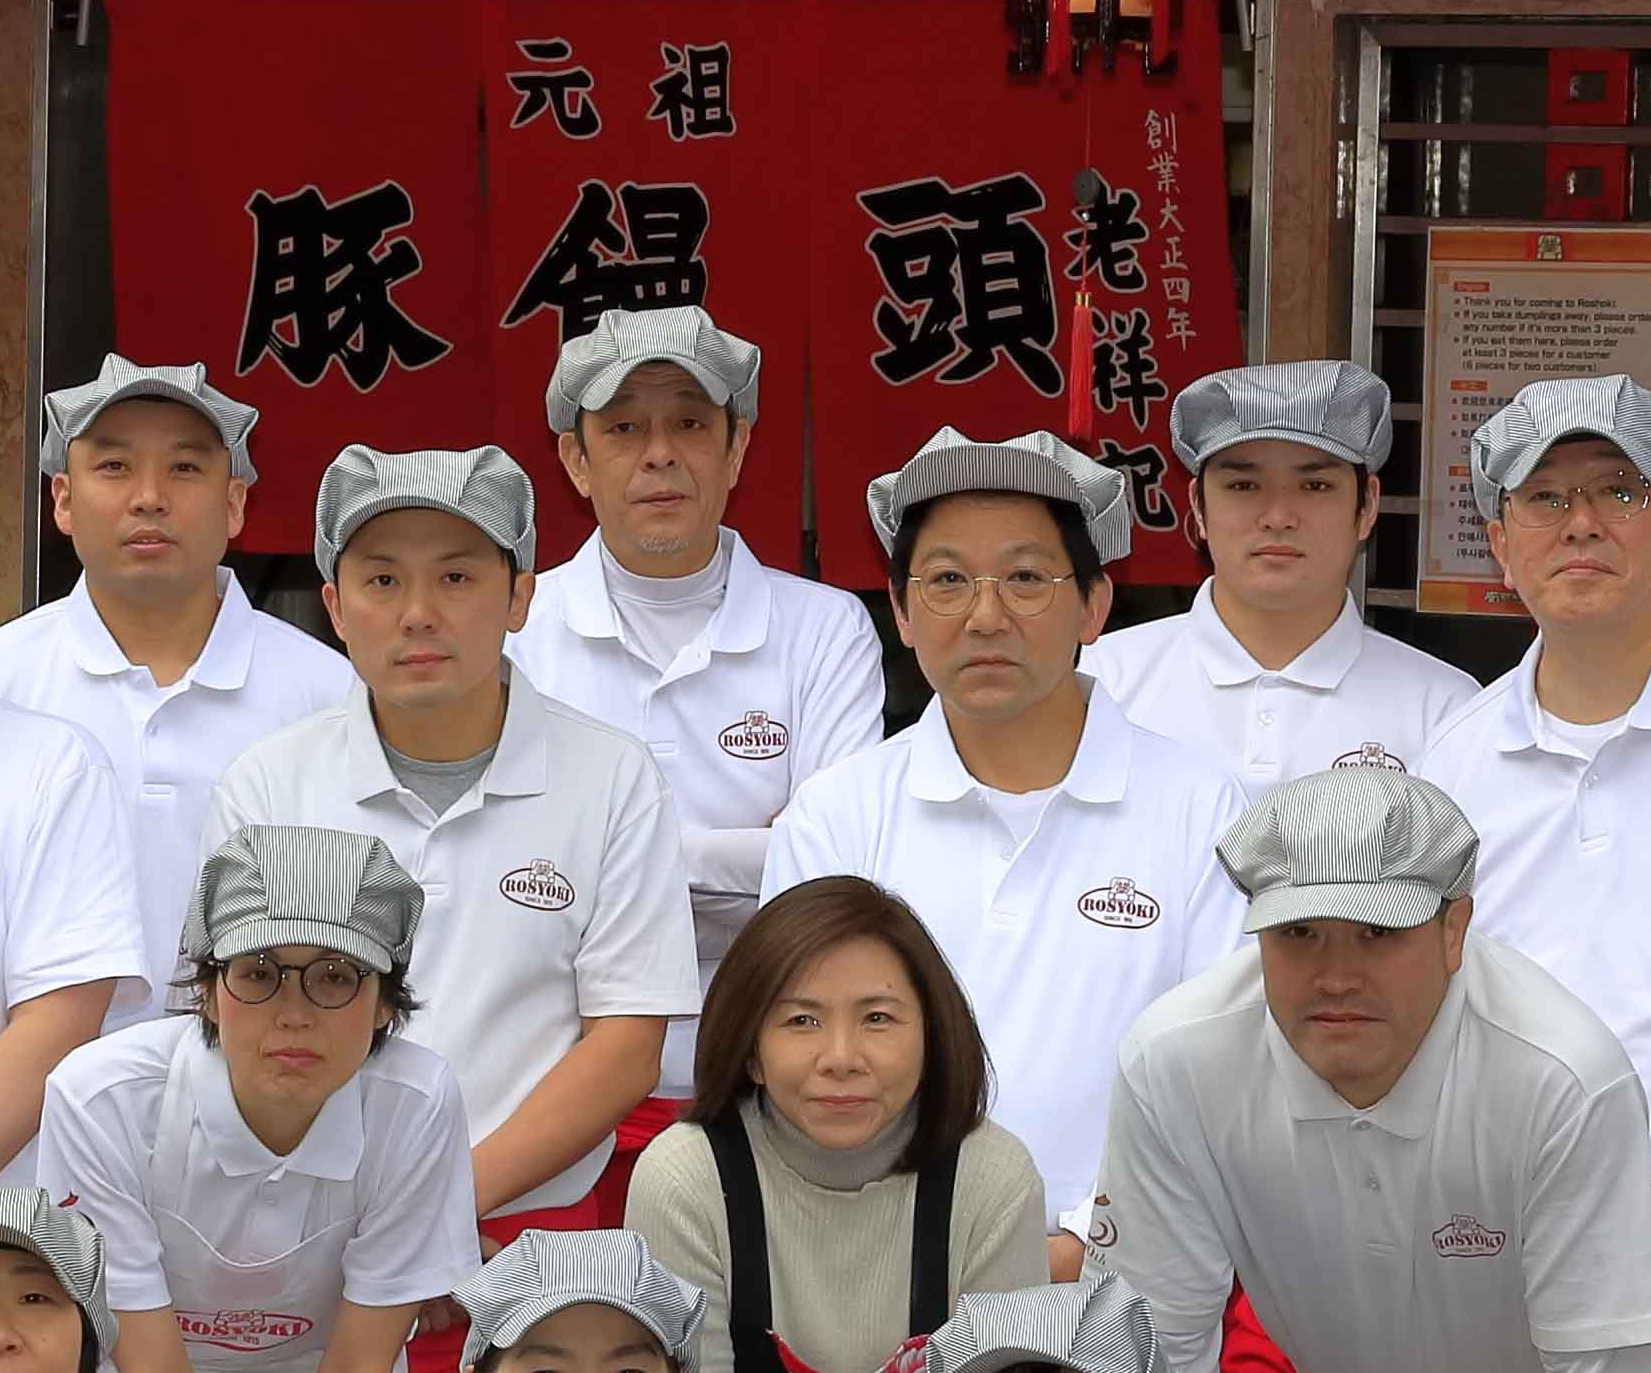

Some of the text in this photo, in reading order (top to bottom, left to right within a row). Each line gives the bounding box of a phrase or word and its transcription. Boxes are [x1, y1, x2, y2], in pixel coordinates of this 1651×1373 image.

[506, 35, 737, 142] 元祖
[1145, 108, 1197, 355] 創業大正四年
[723, 732, 786, 747] ROSYOKI
[505, 878, 570, 903] ROSYOKI
[1084, 898, 1155, 919] ROSYOKI
